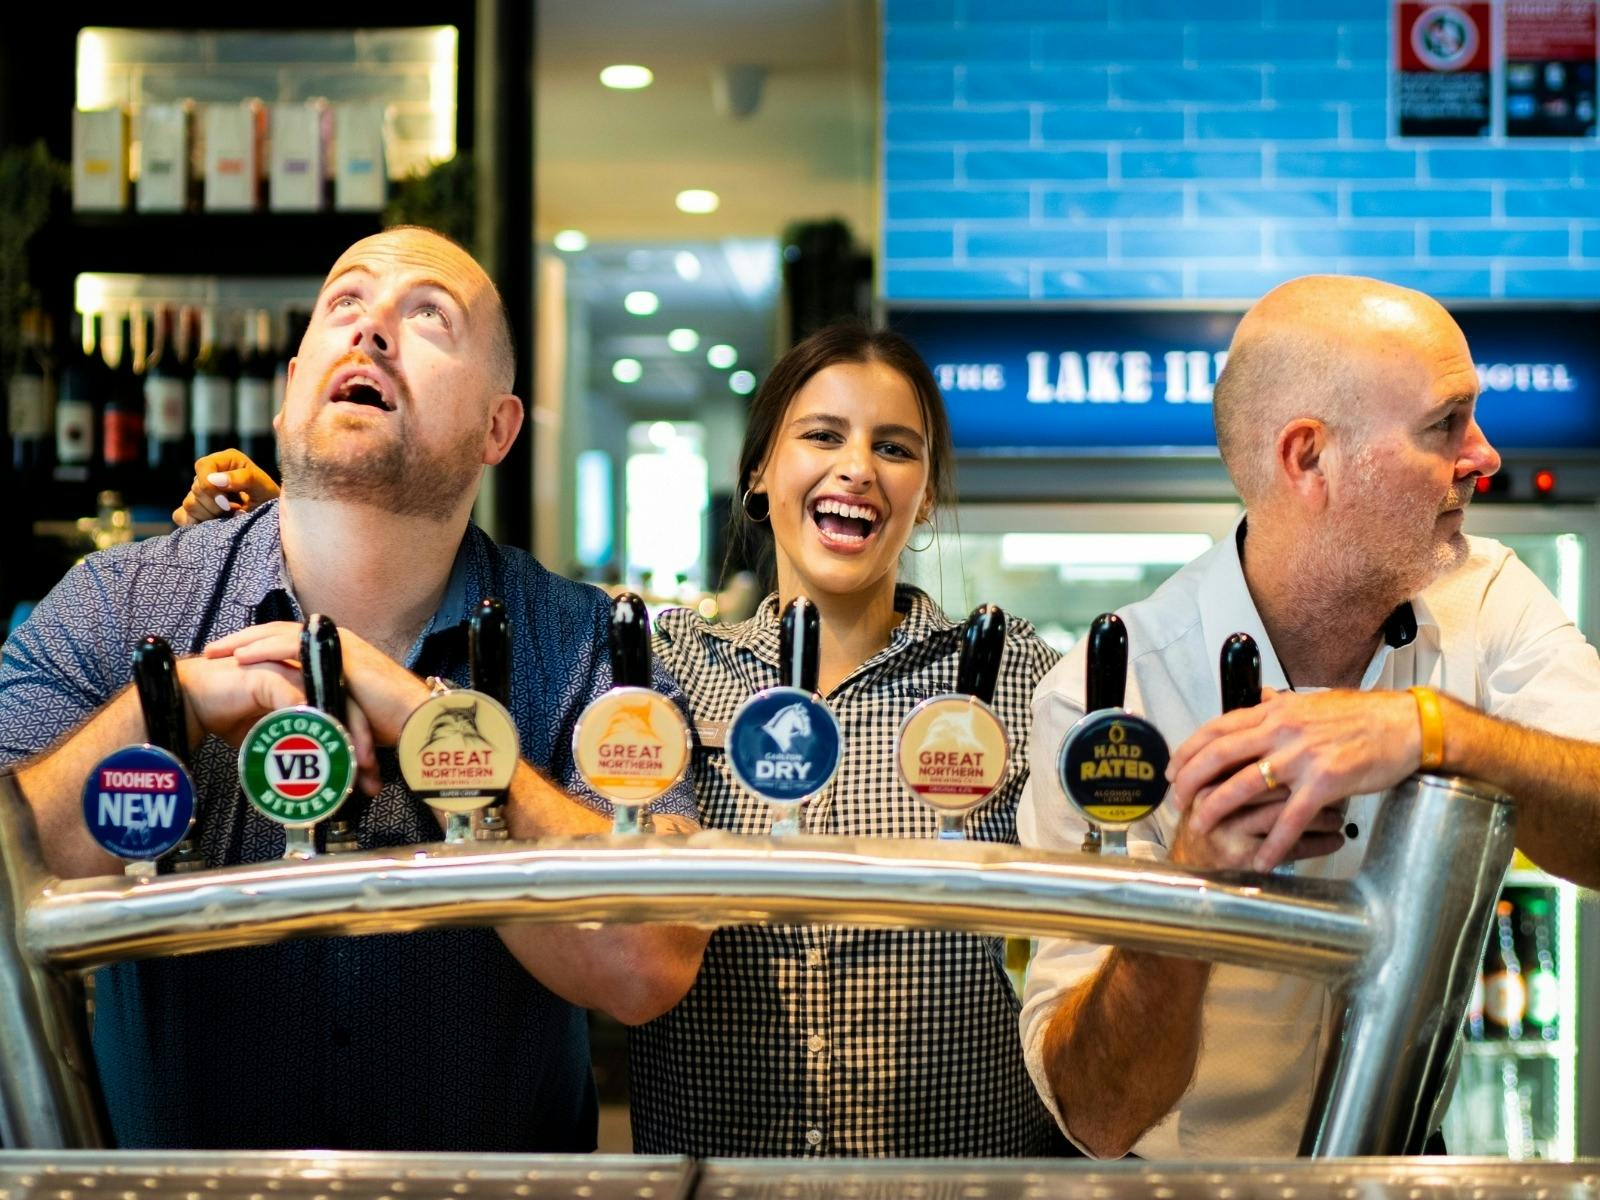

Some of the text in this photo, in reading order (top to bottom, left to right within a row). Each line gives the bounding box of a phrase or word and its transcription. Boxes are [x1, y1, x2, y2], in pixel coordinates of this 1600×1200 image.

[934, 364, 1005, 391] THE
[1027, 351, 1152, 404] LAKE
[252, 718, 340, 754] VICTORIA
[422, 750, 493, 767] GREAT
[598, 744, 662, 758] GREAT
[919, 751, 985, 766] GREAT
[1094, 744, 1142, 758] HARD
[273, 754, 320, 780] VB
[422, 767, 493, 778] NORTHERN
[598, 760, 663, 769] NORTHERN
[755, 761, 812, 780] DRY
[919, 767, 985, 777] NORTHERN
[1080, 759, 1155, 781] RATED
[103, 771, 175, 789] TOOHEYS
[260, 787, 337, 815] BITTER
[1094, 790, 1142, 798] ALCOHOLIC
[98, 792, 178, 829] NEW
